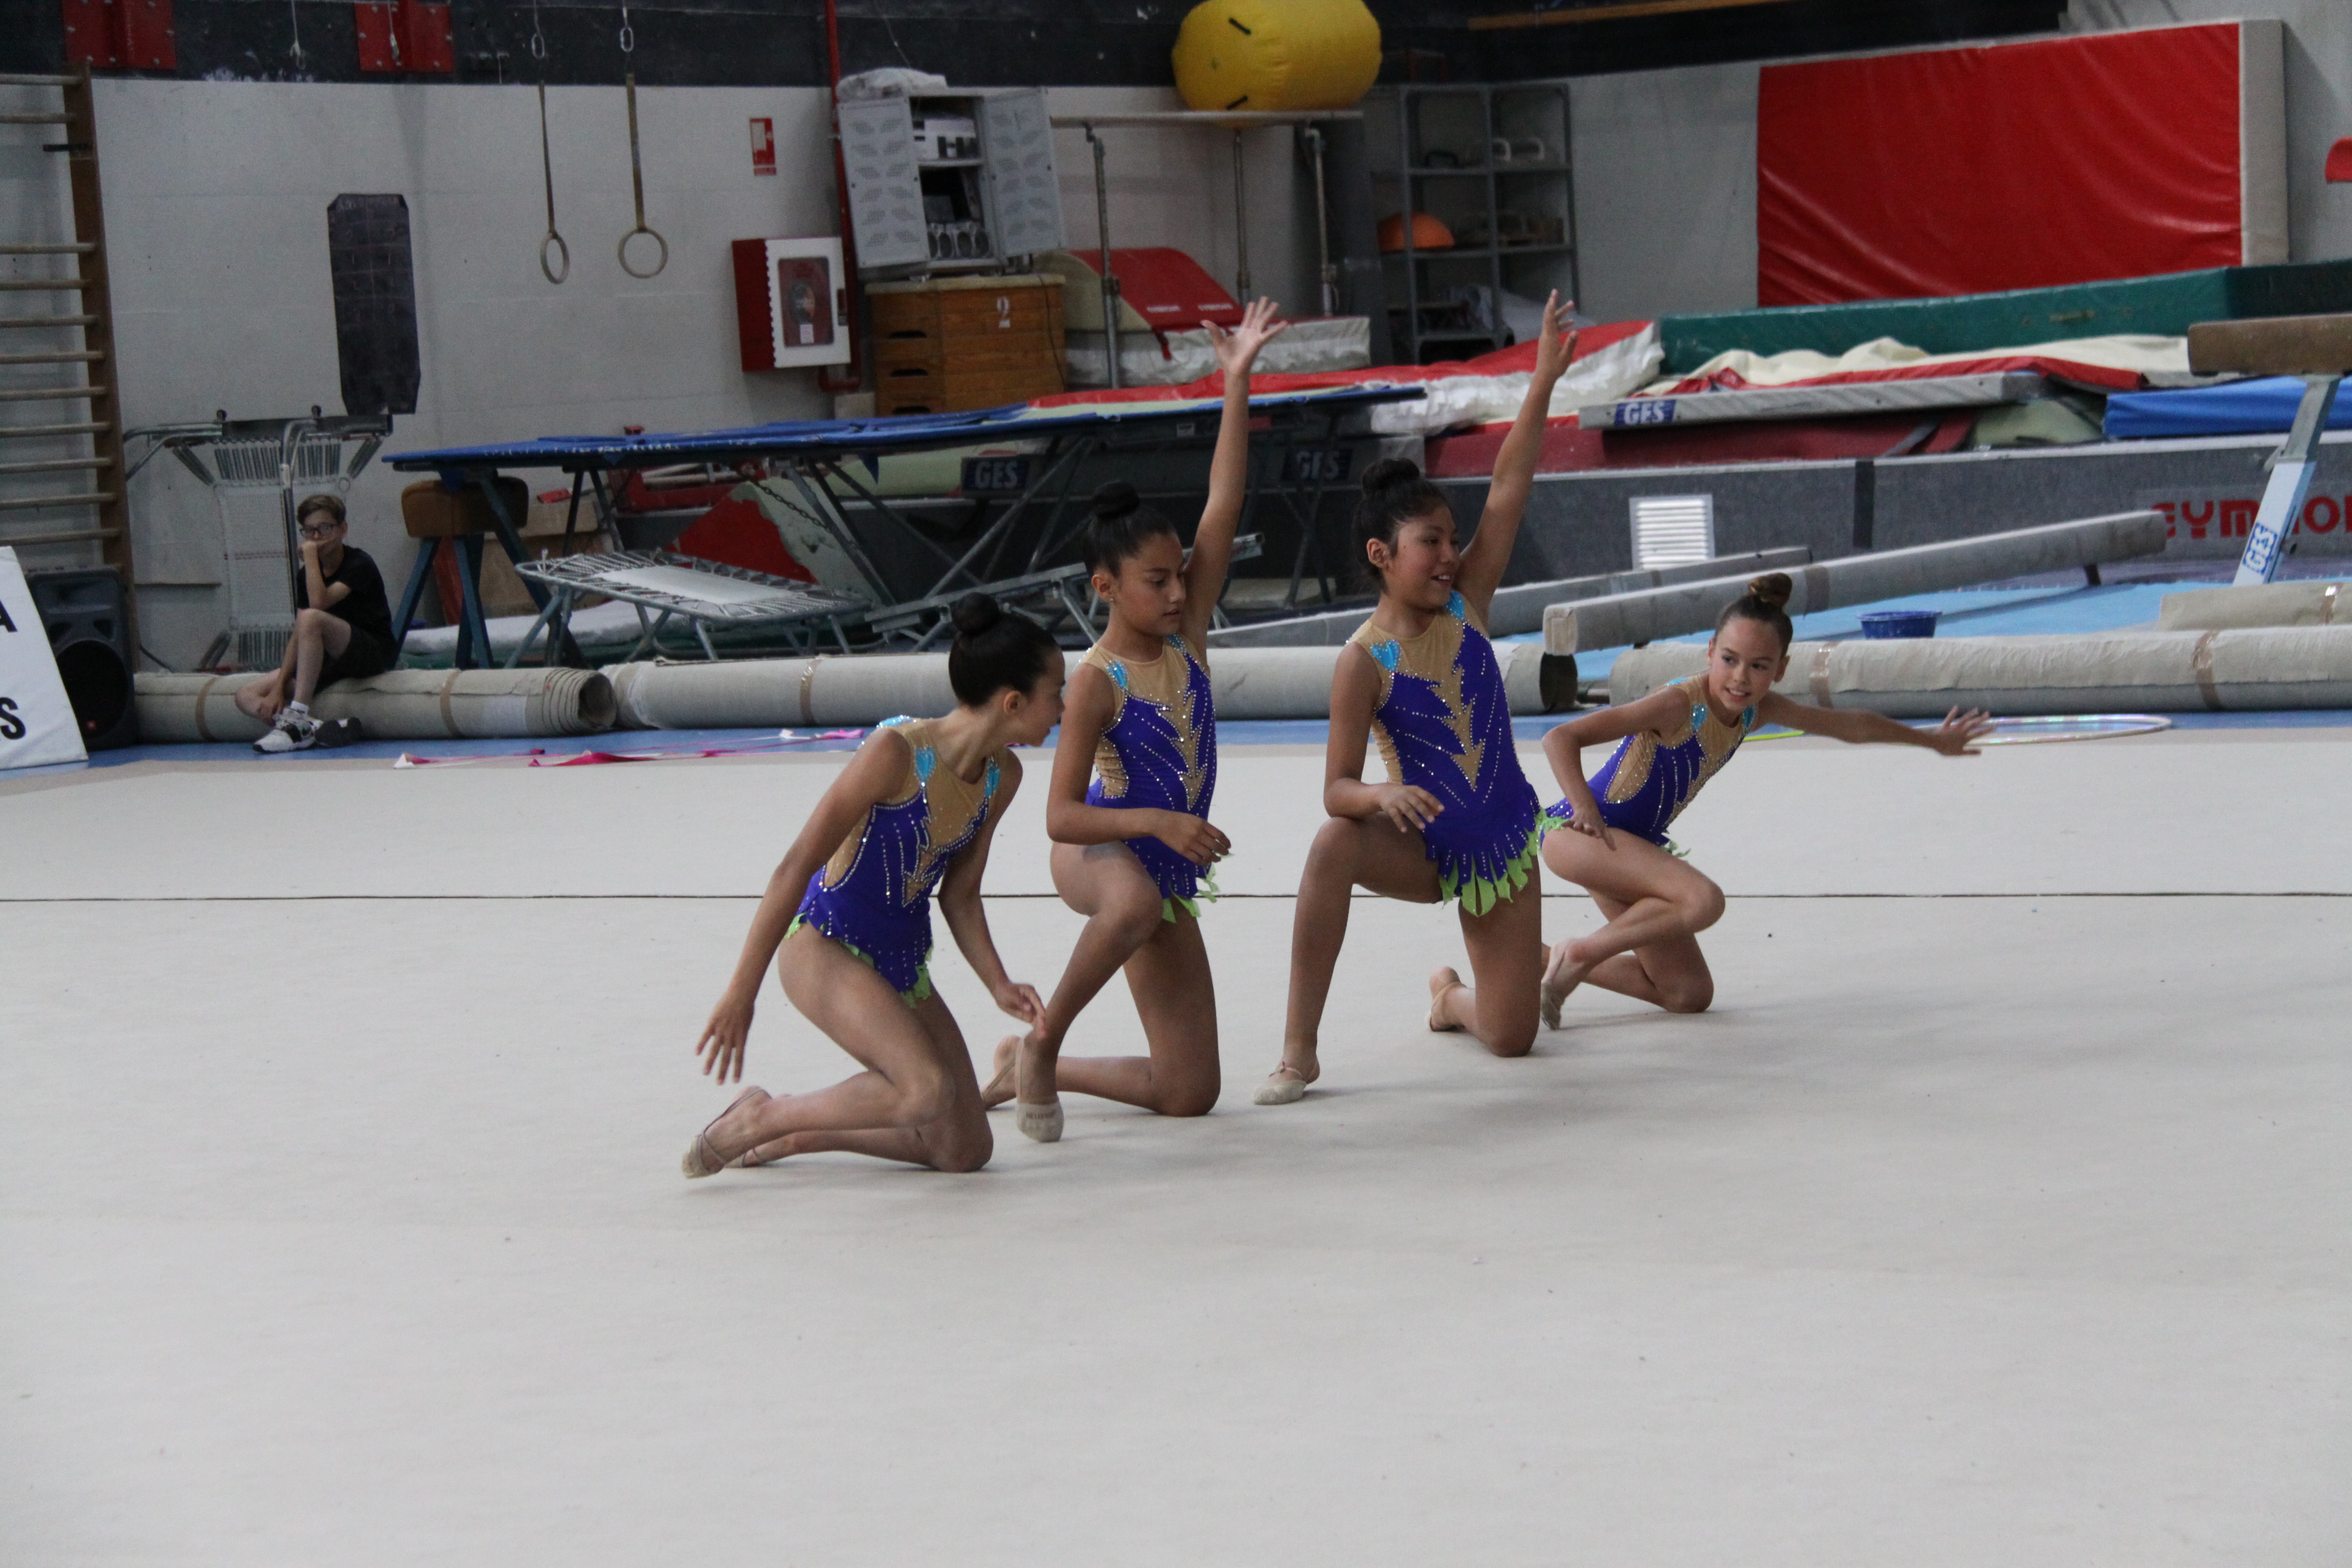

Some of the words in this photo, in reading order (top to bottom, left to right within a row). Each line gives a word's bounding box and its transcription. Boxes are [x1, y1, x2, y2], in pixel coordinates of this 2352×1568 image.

[996, 296, 1010, 328] 2
[1624, 401, 1665, 425] GES
[975, 461, 1018, 489] GES
[2246, 525, 2275, 571] GES
